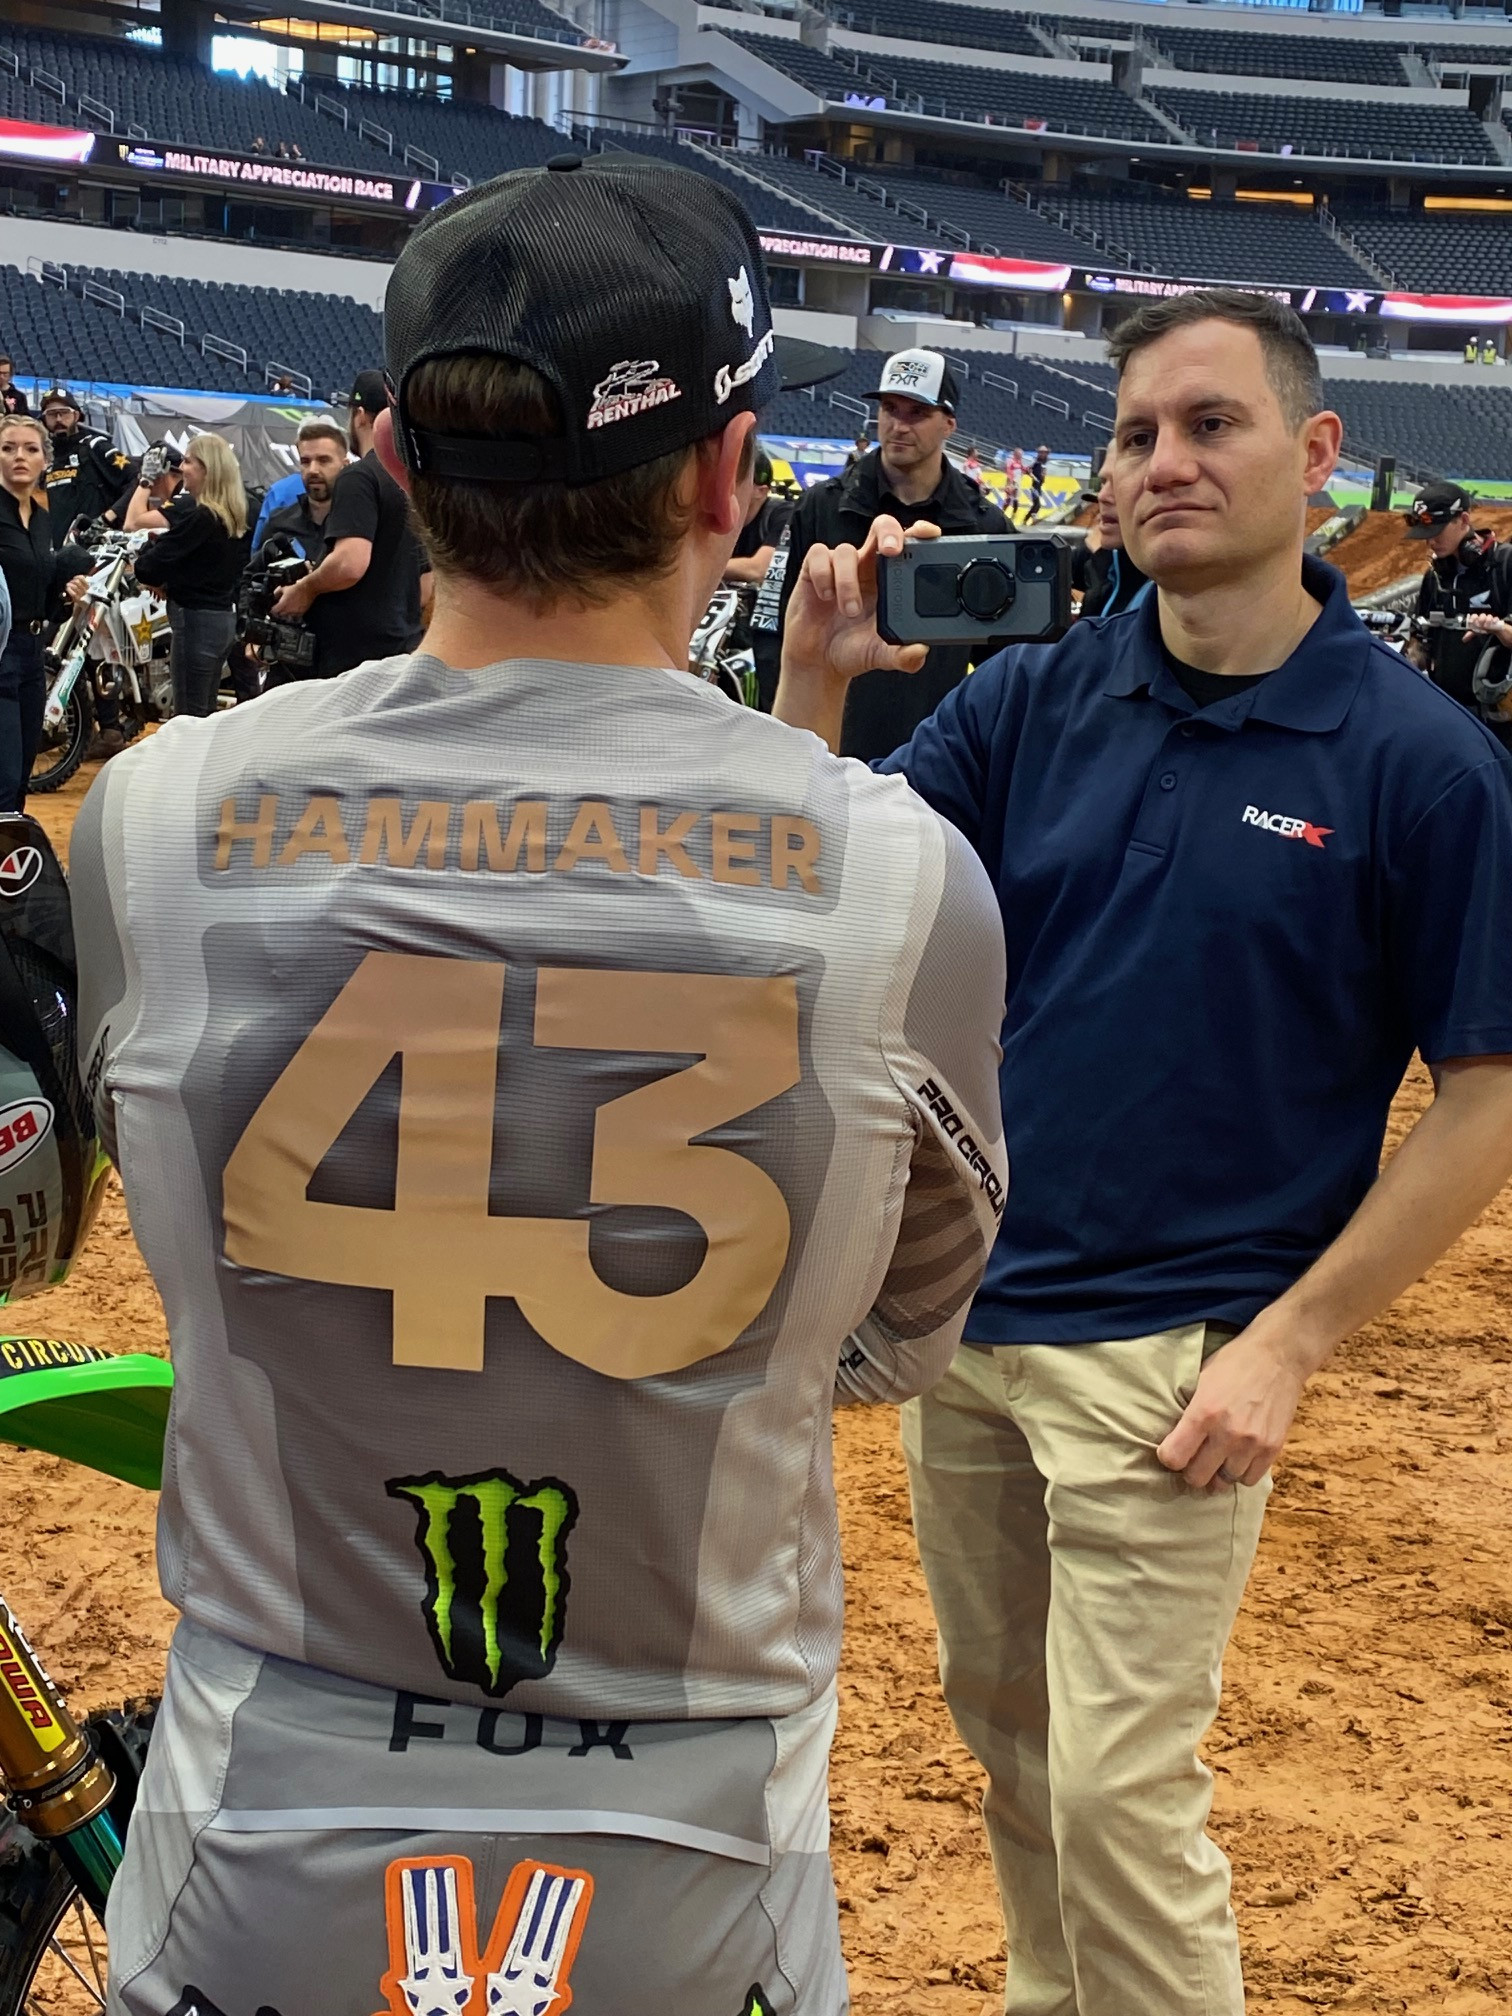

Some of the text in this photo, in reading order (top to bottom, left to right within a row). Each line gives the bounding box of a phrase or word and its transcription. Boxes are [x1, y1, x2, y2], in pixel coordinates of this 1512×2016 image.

[165, 151, 240, 177] MILITARY
[240, 161, 352, 193] APPRECIATION
[354, 178, 394, 200] RACE
[759, 236, 871, 264] PPRECIATION RACE
[587, 384, 682, 430] RENTHAL
[889, 373, 919, 387] FXR
[213, 794, 823, 895] HAMMAKER
[917, 1077, 963, 1137] PRO
[221, 950, 802, 1381] 43
[388, 1690, 634, 1761] FOX
